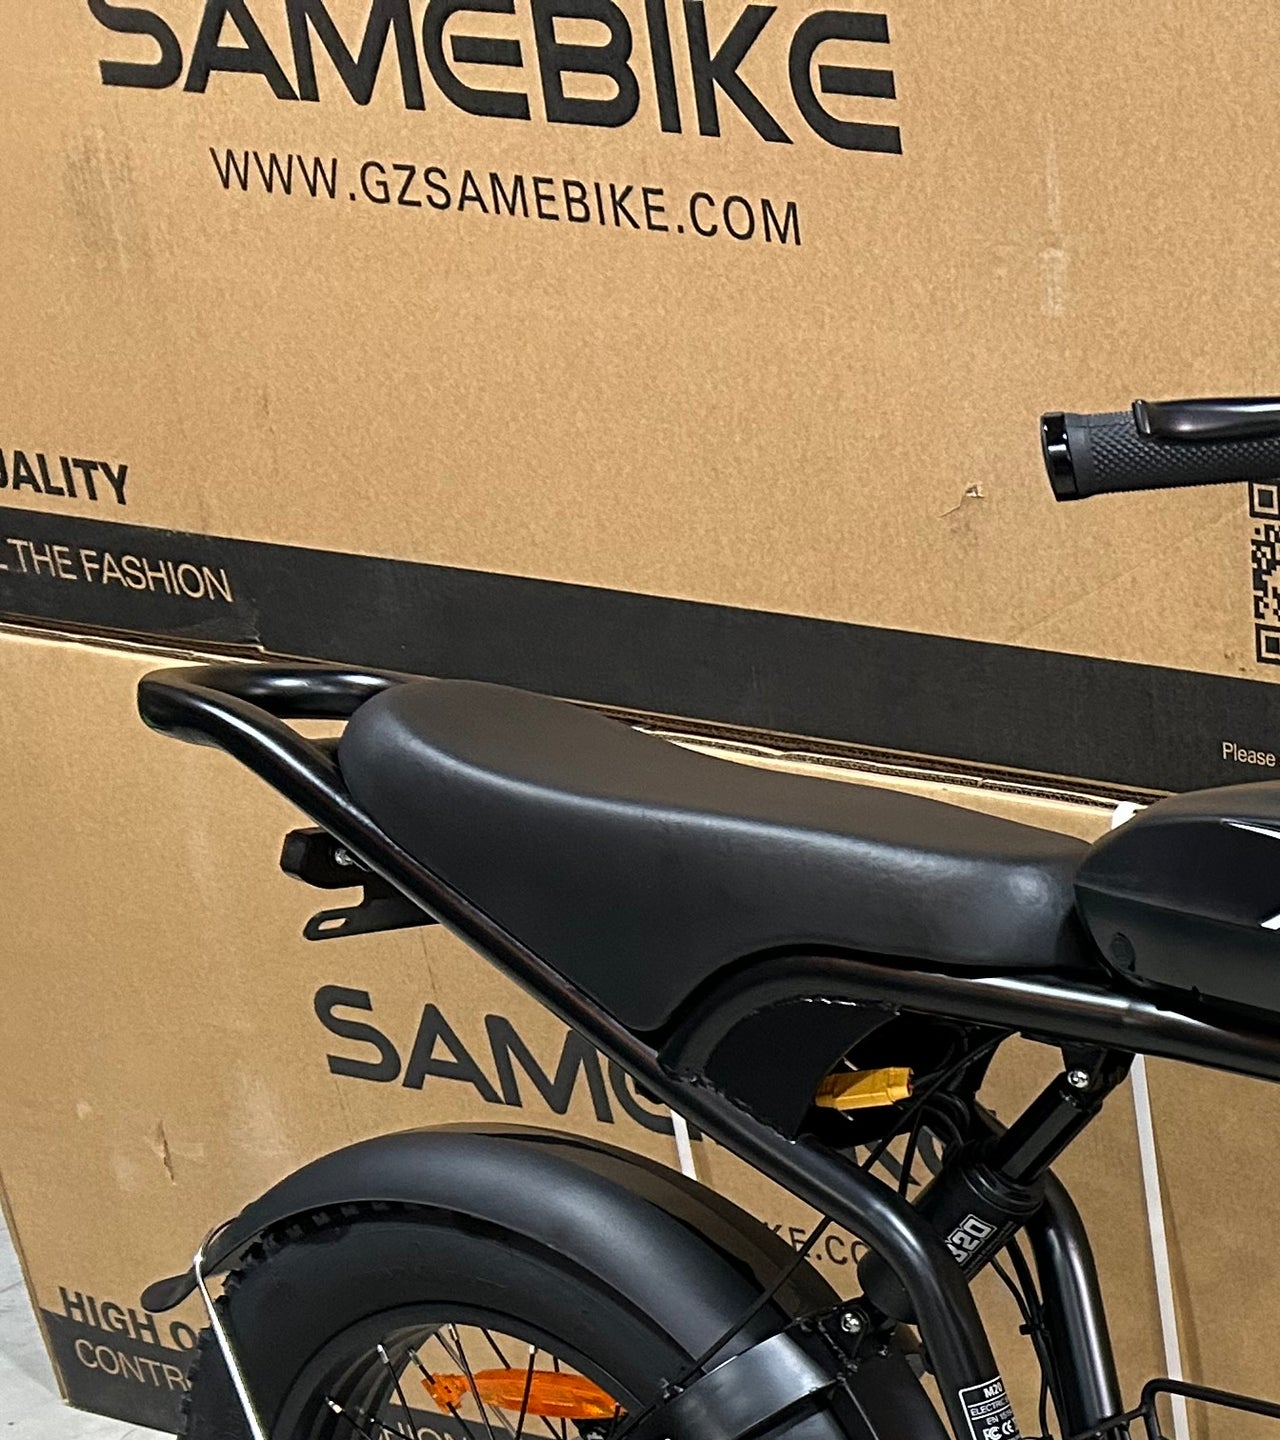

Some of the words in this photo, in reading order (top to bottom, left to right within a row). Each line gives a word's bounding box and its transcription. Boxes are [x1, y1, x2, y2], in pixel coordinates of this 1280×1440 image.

[88, 0, 902, 155] SAMEBIKE
[209, 147, 802, 246] WWW.GZSAMEBIKE.COM
[0, 449, 128, 505] ALITY
[79, 549, 234, 603] FASHION
[1222, 741, 1276, 767] Please
[58, 1285, 163, 1347] HIGH
